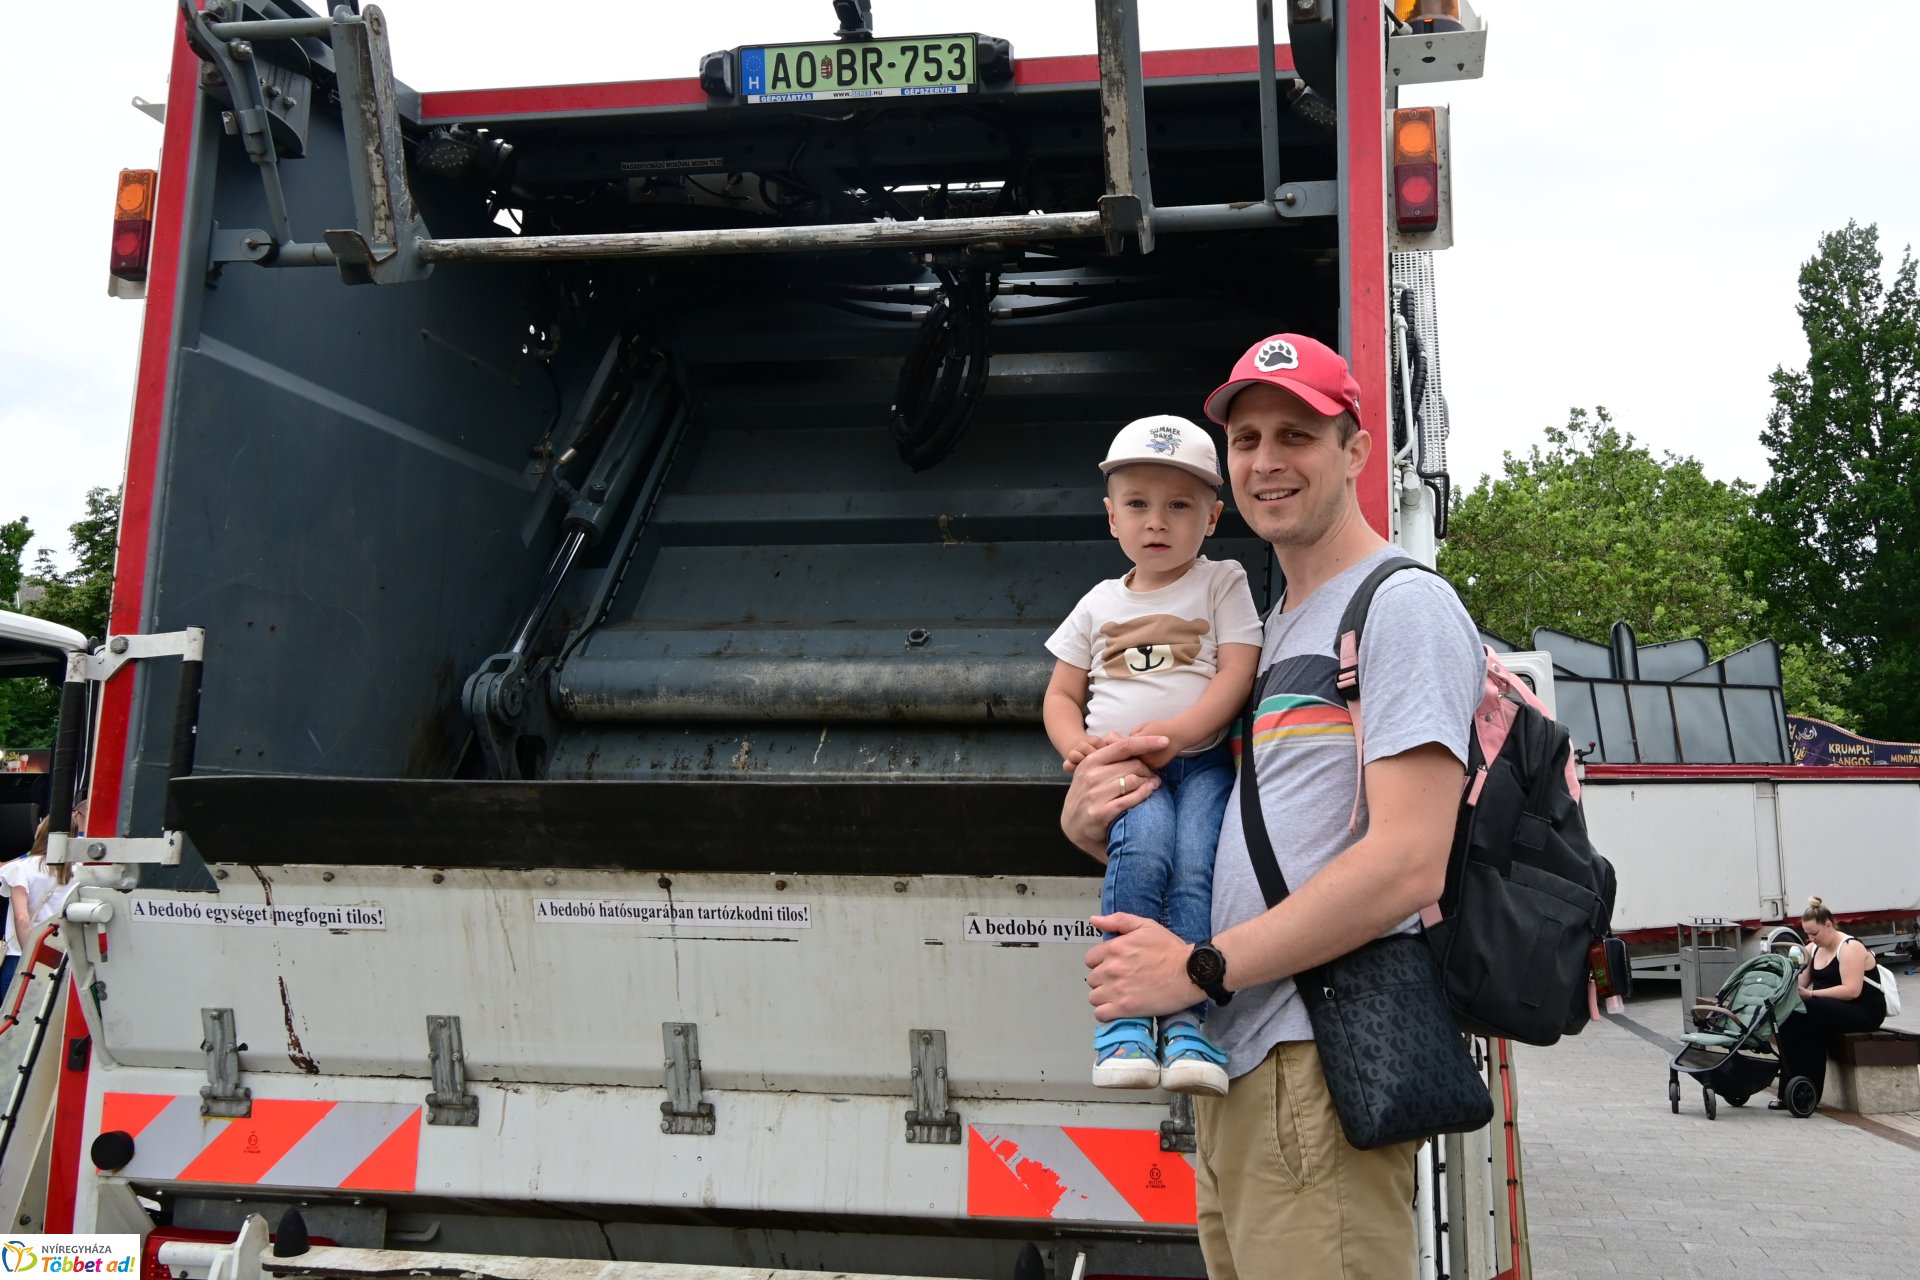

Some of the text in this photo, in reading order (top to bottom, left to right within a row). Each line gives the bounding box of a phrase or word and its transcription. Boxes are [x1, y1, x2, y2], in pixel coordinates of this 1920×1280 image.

[837, 43, 967, 87] BR-753
[749, 76, 760, 90] H
[904, 86, 953, 95] GÉPSZERVIZ
[1150, 426, 1181, 436] SUMMER
[134, 901, 383, 927] A bedobó egységet megfogni tilos!
[538, 902, 808, 922] A bedobó hatósugarában tartózkodni tilos!
[968, 918, 982, 935] A
[986, 918, 1047, 936] bedobó
